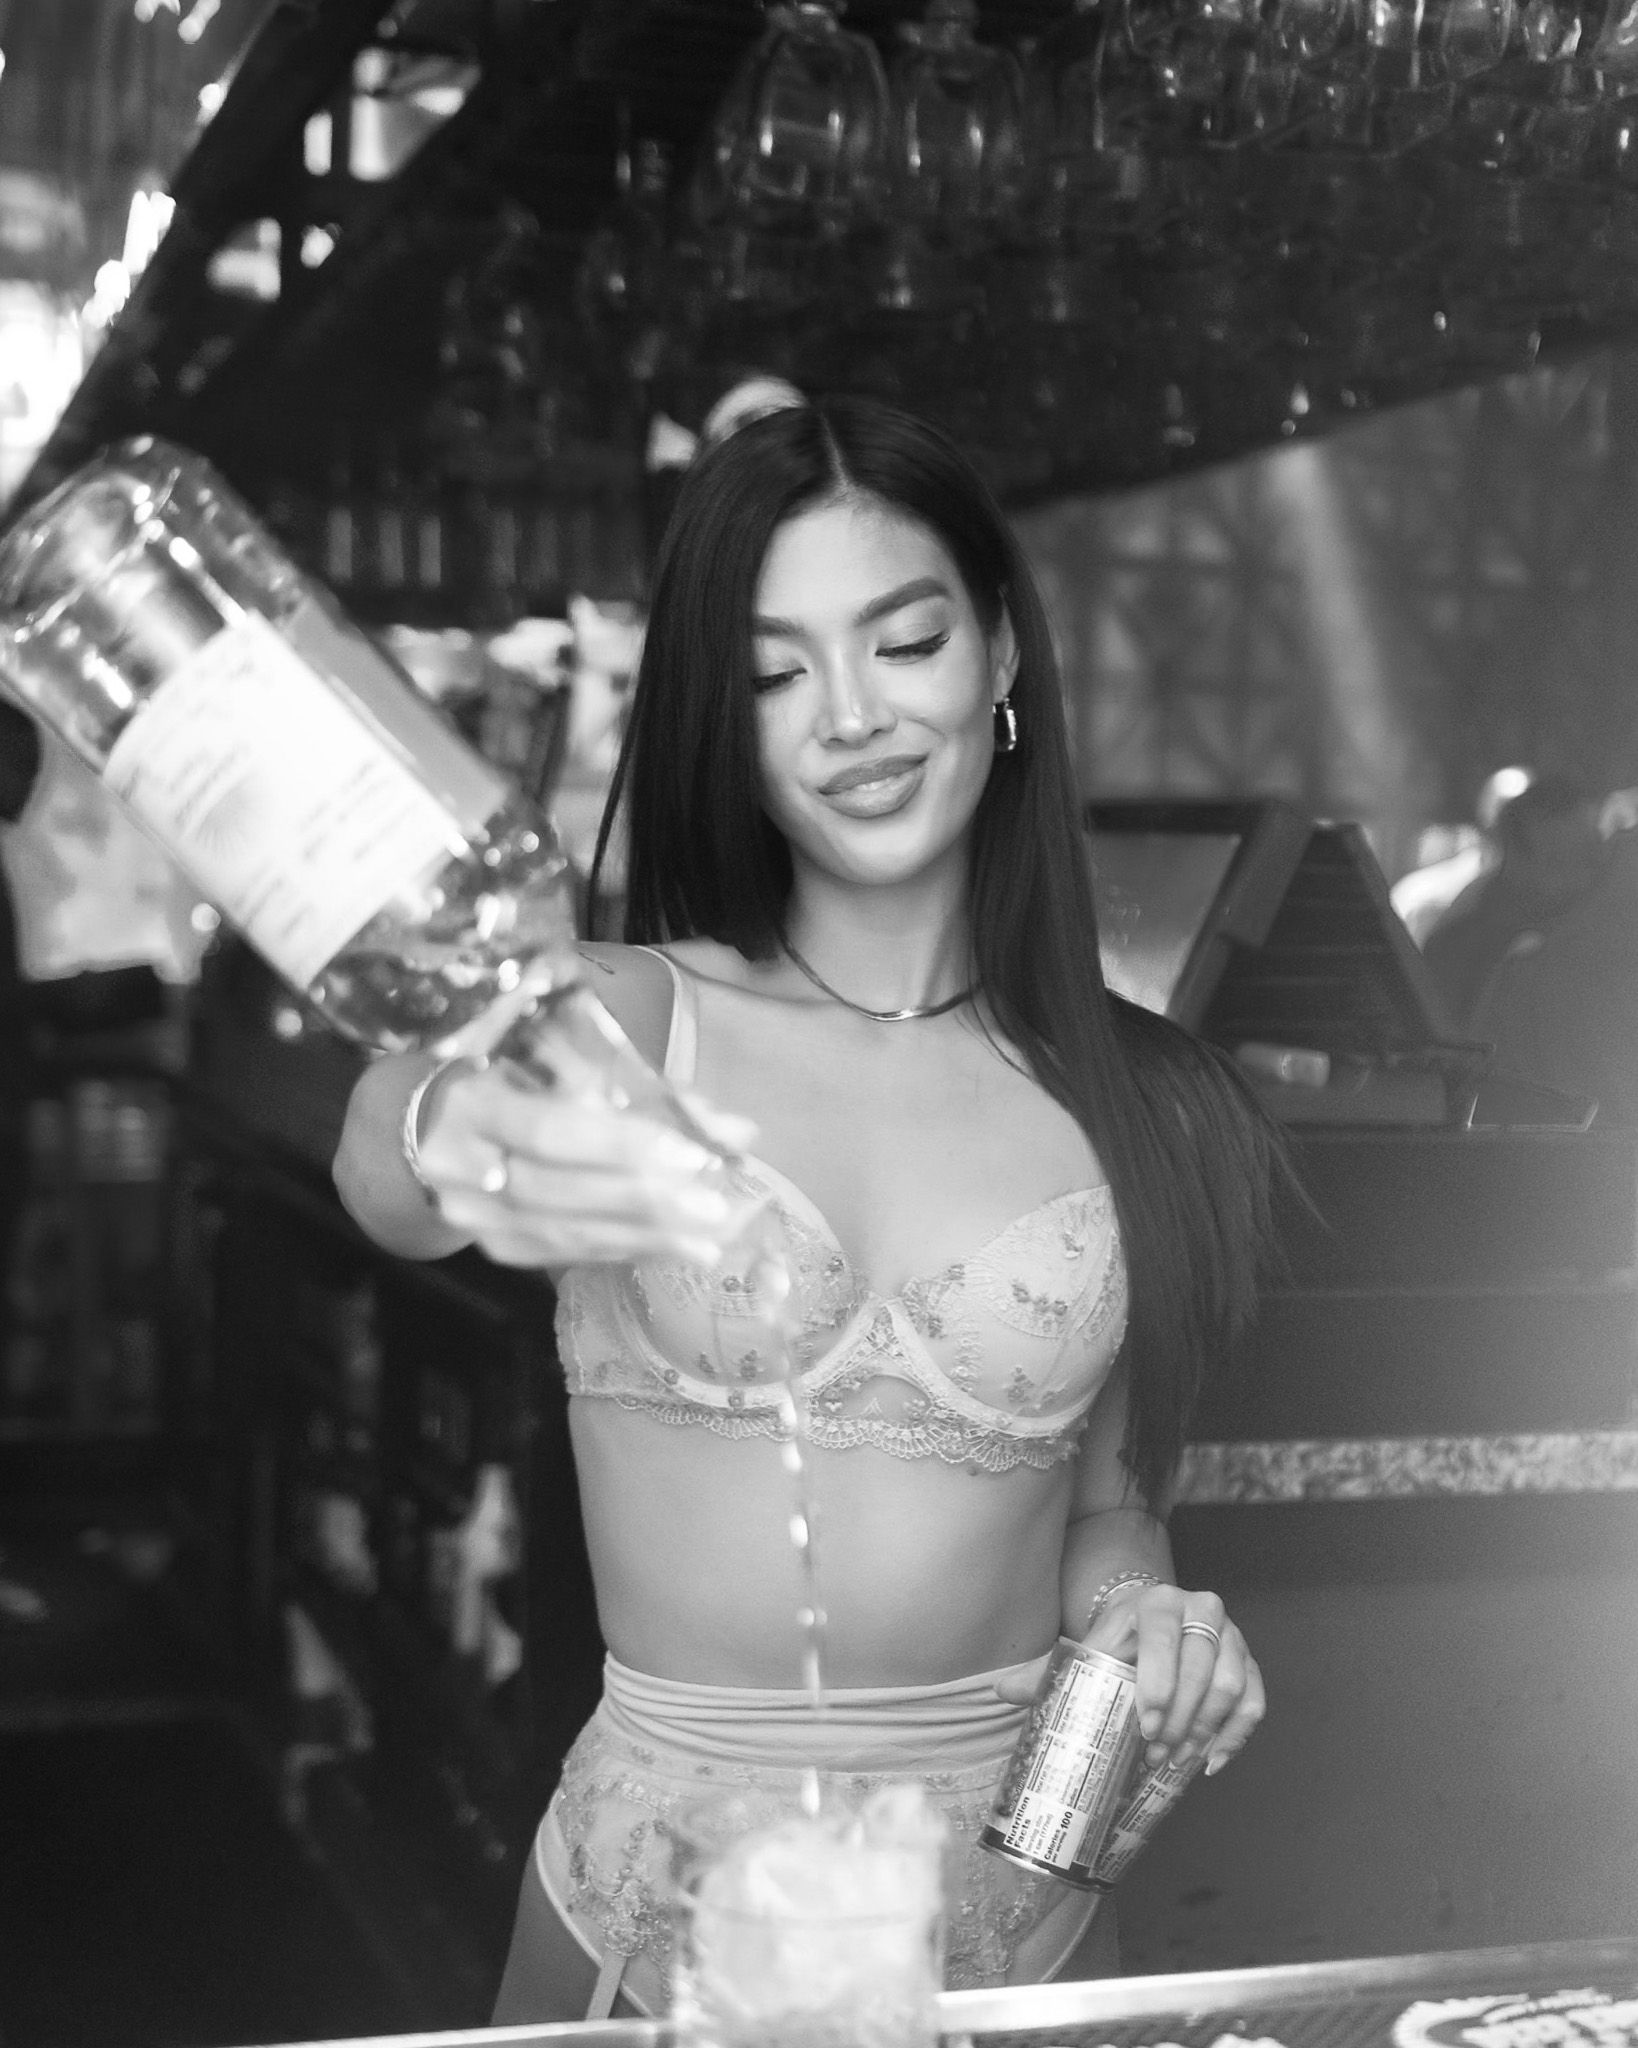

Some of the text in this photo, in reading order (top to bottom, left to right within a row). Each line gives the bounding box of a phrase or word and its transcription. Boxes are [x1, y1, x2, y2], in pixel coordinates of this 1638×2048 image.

[1005, 1794, 1031, 1845] Nutrition
[1012, 1816, 1031, 1849] Facts
[1042, 1827, 1061, 1861] Calories
[1058, 1809, 1074, 1831] 100
